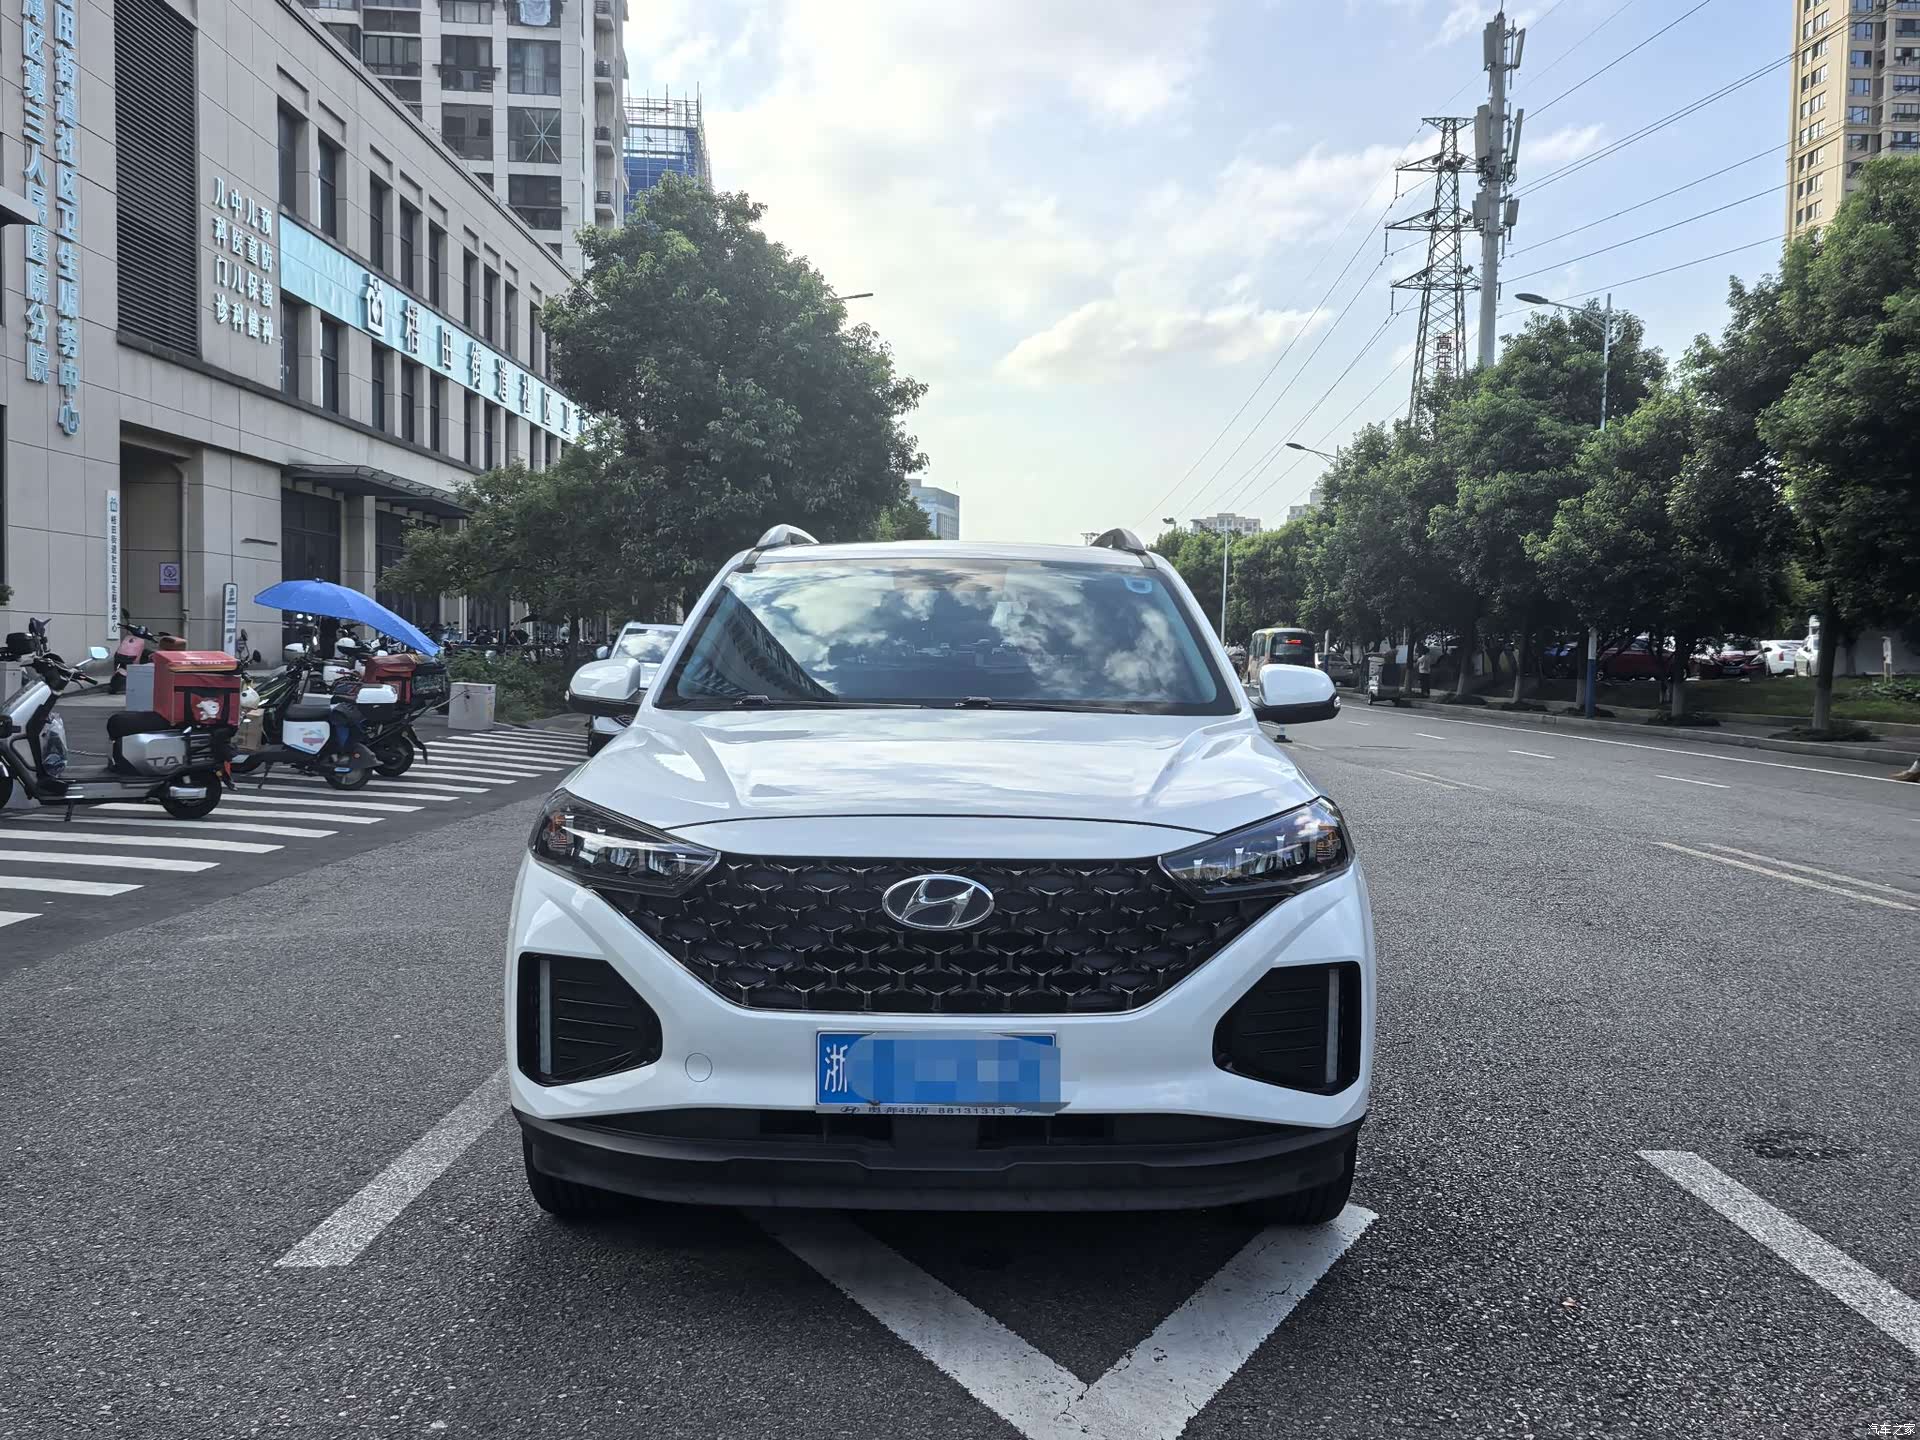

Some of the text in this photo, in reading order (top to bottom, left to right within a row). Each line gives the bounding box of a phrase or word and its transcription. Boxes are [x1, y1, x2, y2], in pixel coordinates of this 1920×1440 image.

[55, 0, 80, 435] 田街道社区卫生服务中心
[213, 176, 229, 324] 儿科门诊
[230, 188, 245, 333] 中医儿科
[245, 197, 260, 339] 儿童保健
[259, 206, 274, 345] 预防接种
[403, 302, 588, 435] 梧田街道社区卫
[824, 1043, 849, 1093] 浙
[938, 1106, 1006, 1115] 88131313
